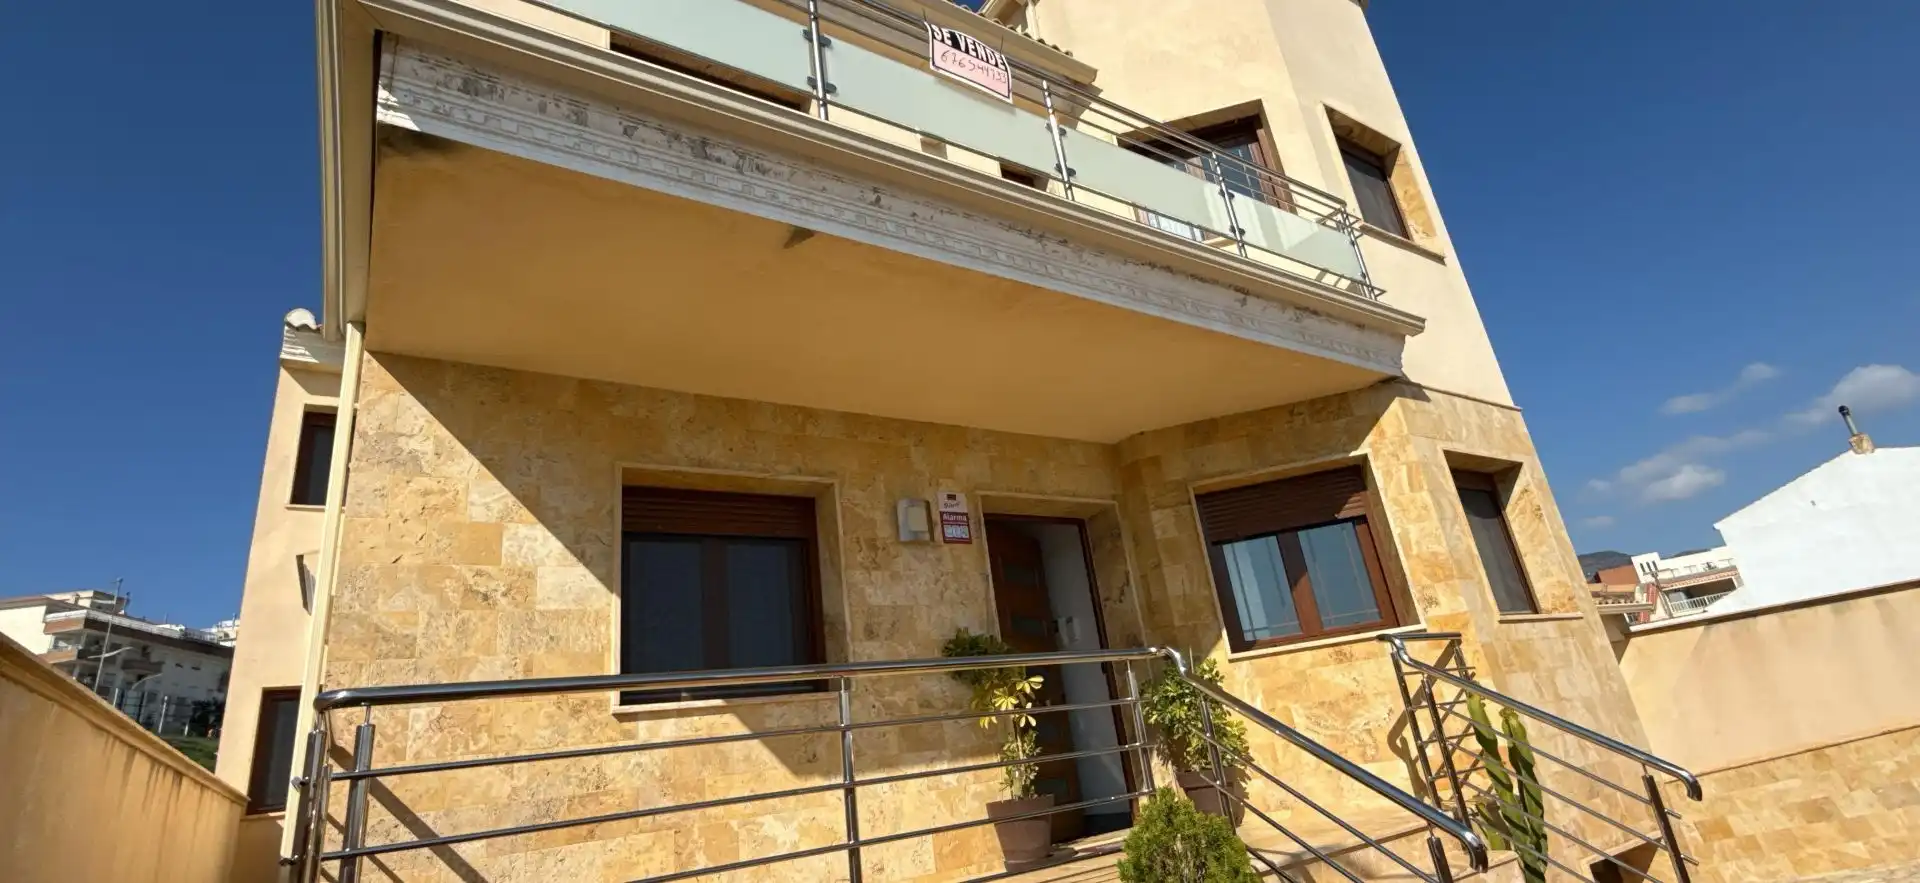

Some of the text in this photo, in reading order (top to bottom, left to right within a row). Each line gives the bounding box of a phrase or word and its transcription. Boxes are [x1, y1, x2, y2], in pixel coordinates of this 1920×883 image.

[931, 24, 1006, 71] SE VENDE
[942, 513, 967, 521] Alarma
